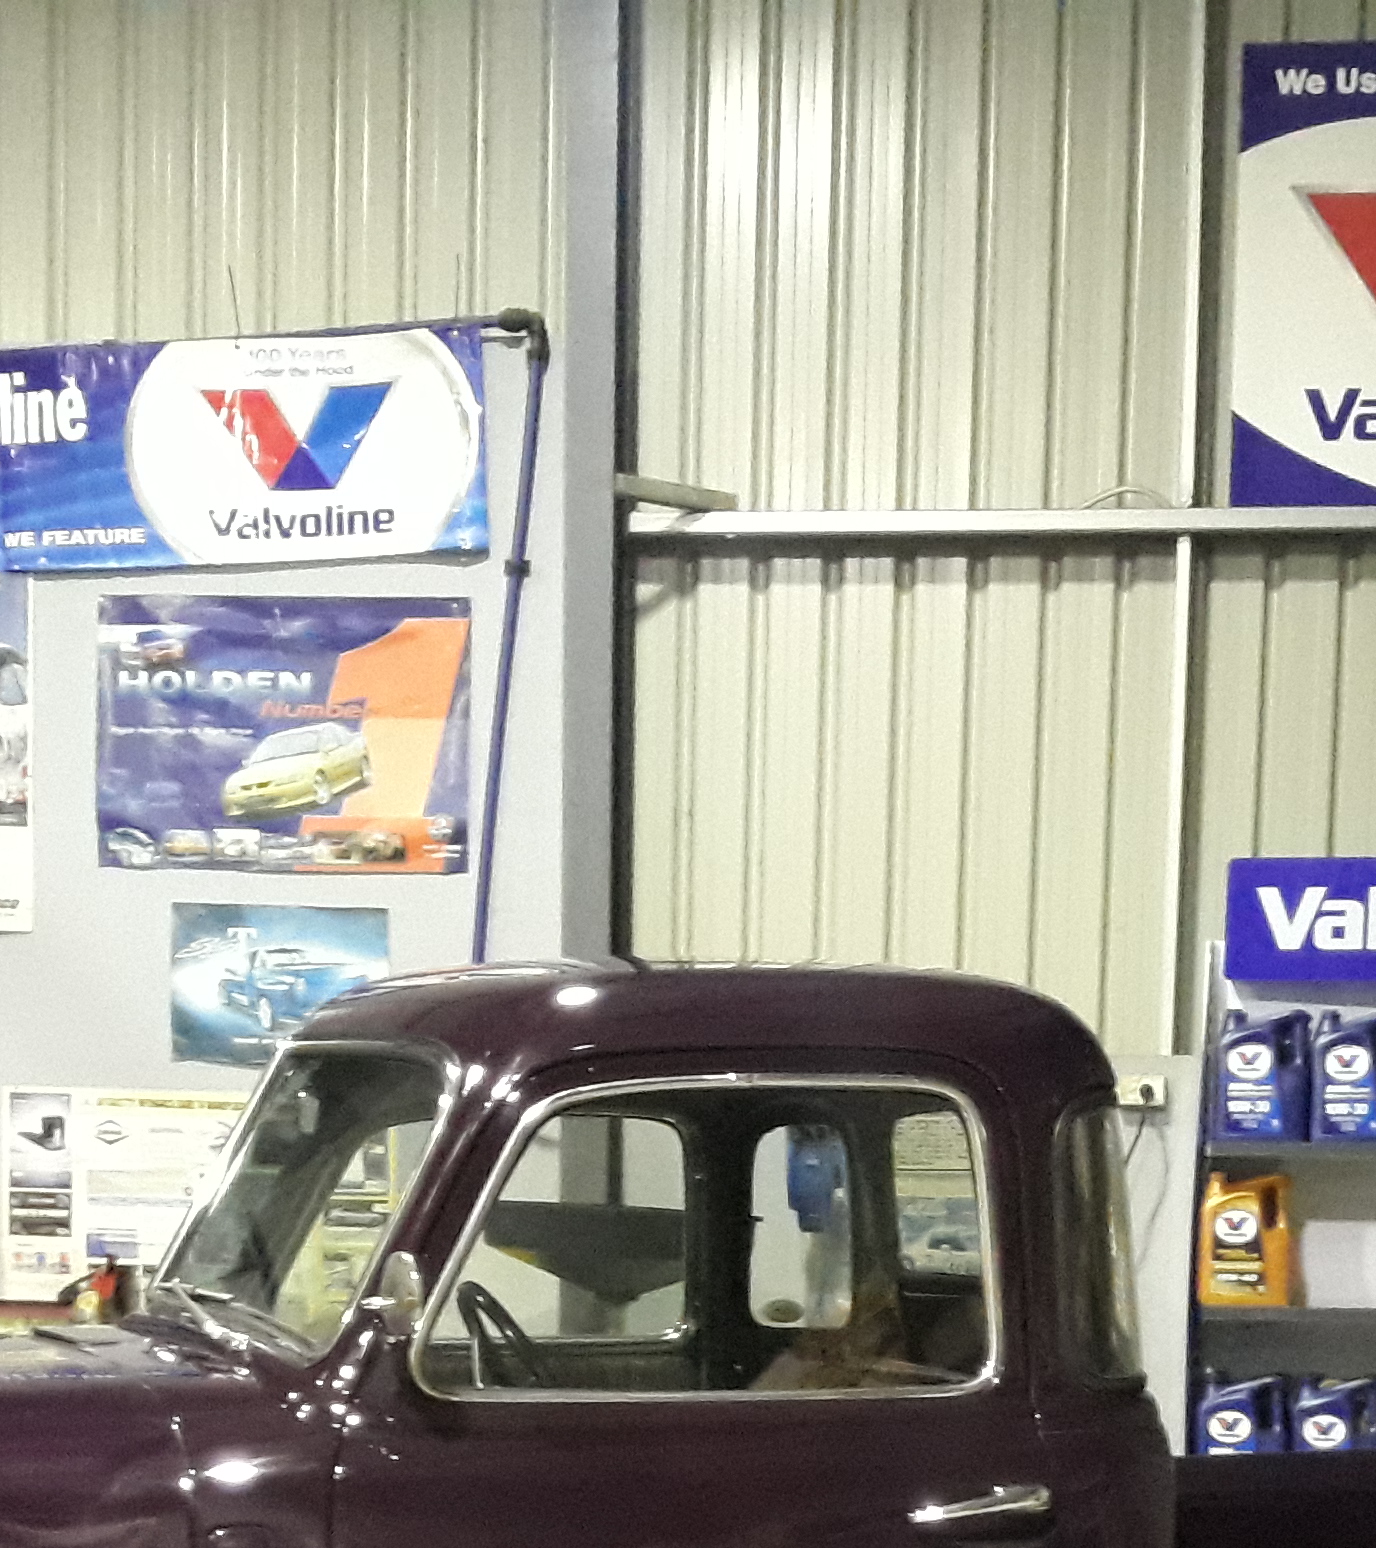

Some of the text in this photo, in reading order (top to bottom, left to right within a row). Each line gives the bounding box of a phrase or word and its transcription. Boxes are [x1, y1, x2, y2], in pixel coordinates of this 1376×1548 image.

[1274, 67, 1325, 96] We
[208, 504, 396, 540] Valvoline
[3, 527, 146, 548] WE FEATURE
[117, 669, 312, 693] HOLDEN
